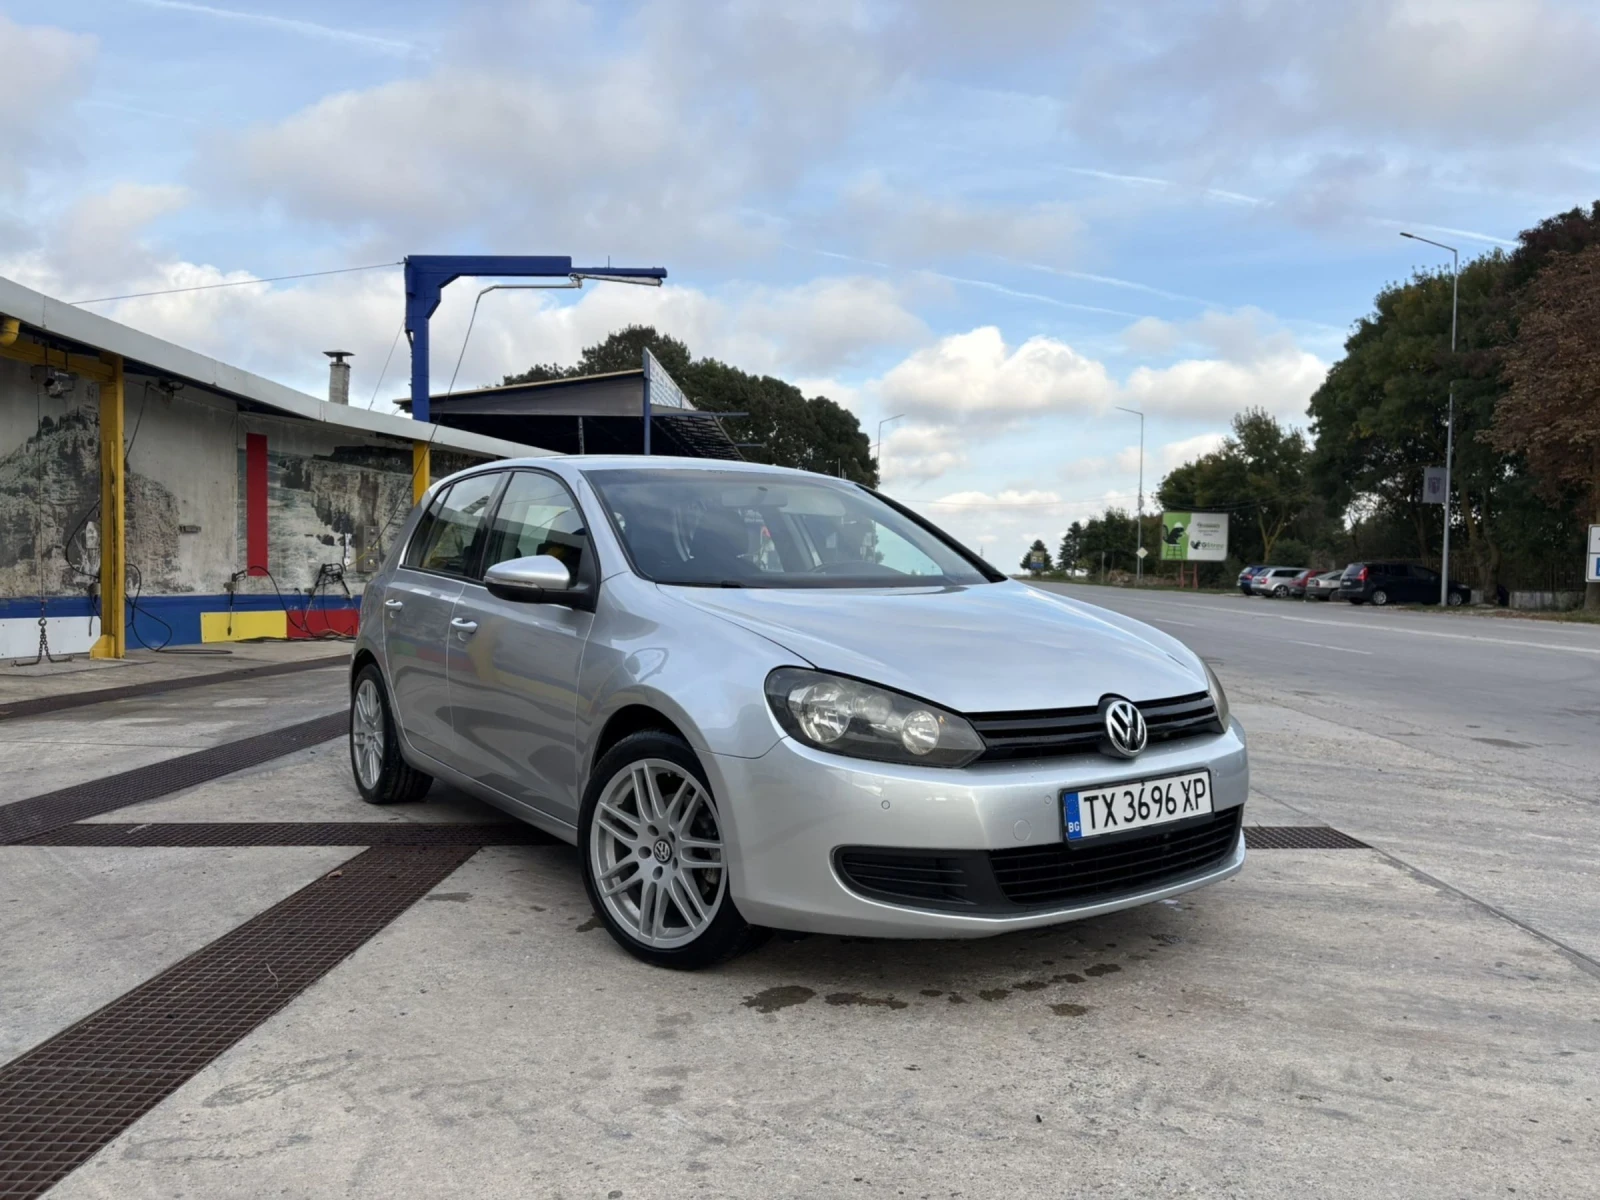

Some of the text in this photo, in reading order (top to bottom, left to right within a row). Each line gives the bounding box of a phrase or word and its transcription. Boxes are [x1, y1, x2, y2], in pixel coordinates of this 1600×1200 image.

[1107, 701, 1146, 752] VW
[1068, 821, 1080, 832] BG
[1084, 778, 1206, 829] TX 3696 XP
